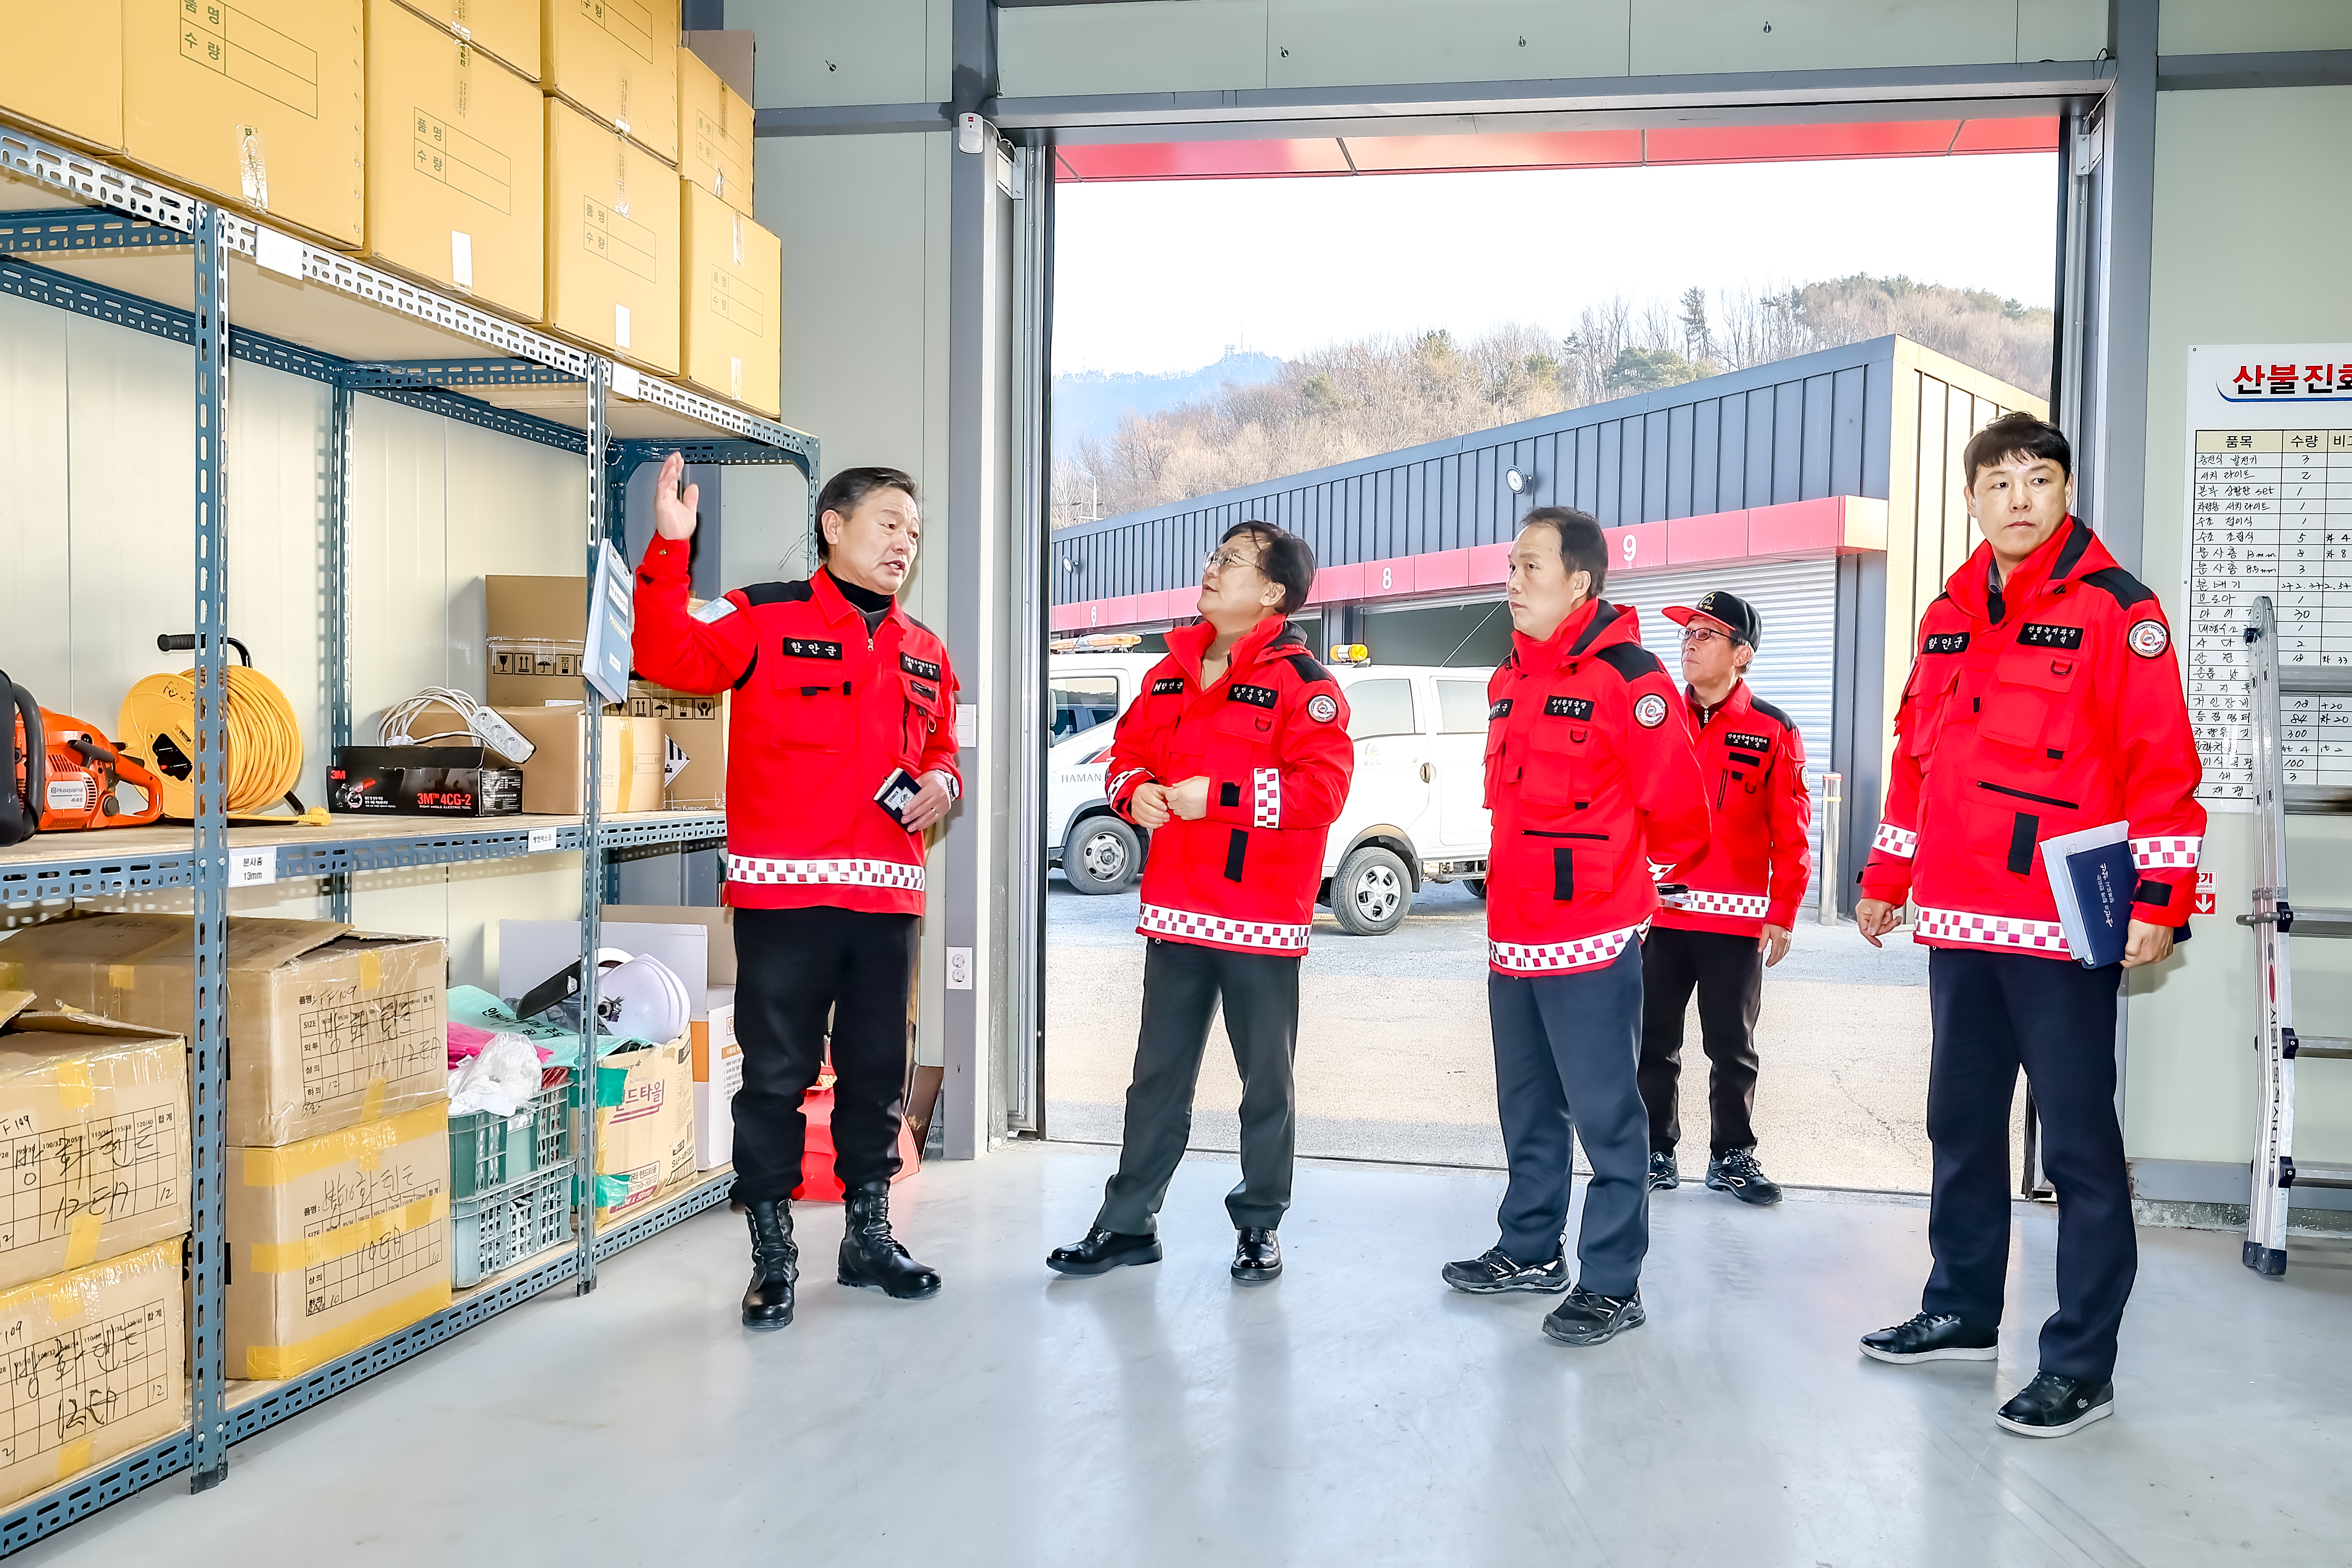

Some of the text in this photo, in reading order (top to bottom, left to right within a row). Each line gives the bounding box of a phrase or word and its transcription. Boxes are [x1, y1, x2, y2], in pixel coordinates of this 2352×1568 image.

[2225, 436, 2253, 448] 품목
[2290, 435, 2318, 448] 수량
[2230, 455, 2257, 465] 발전기
[2302, 455, 2310, 465] 3
[2201, 470, 2311, 481] 서치 라이트 2
[2198, 485, 2219, 497] 본부
[2224, 485, 2251, 497] 상황판
[2255, 486, 2275, 496] set
[2197, 501, 2220, 513] 차량용
[2196, 516, 2214, 527] 수조
[2225, 516, 2252, 527] 접이식
[2196, 532, 2214, 543] 수조
[2226, 531, 2254, 543] 조립식
[2298, 533, 2306, 543] 5
[2341, 534, 2351, 542] 4
[1622, 534, 1637, 562] 9
[2297, 549, 2304, 557] 8
[2341, 549, 2347, 558] 8
[2298, 565, 2305, 574] 3
[1382, 566, 1393, 590] 8
[1090, 605, 1098, 626] 6
[2294, 609, 2310, 621] 30
[2027, 626, 2076, 638] 산림녹지과장
[1928, 636, 1963, 650] 함안군
[2030, 633, 2067, 644] 오세석
[791, 641, 837, 657] 함안군
[2287, 730, 2307, 738] 300
[2299, 745, 2310, 753] 4
[2284, 759, 2304, 767] 100
[330, 770, 346, 779] 3M
[1062, 773, 1102, 783] HAMAN
[2289, 772, 2297, 782] 3
[441, 793, 471, 806] 4CG-2
[243, 872, 262, 880] 13mm
[303, 1020, 316, 1029] SIZE
[305, 1064, 320, 1074] 상의
[307, 1086, 321, 1096] 하의
[328, 1080, 342, 1094] 12
[136, 1119, 153, 1128] 120/40
[158, 1112, 172, 1124] 합계
[160, 1187, 174, 1202] 12
[309, 1273, 323, 1285] 상의
[330, 1295, 339, 1307] 10
[147, 1308, 162, 1321] 합계
[152, 1384, 165, 1399] 12
